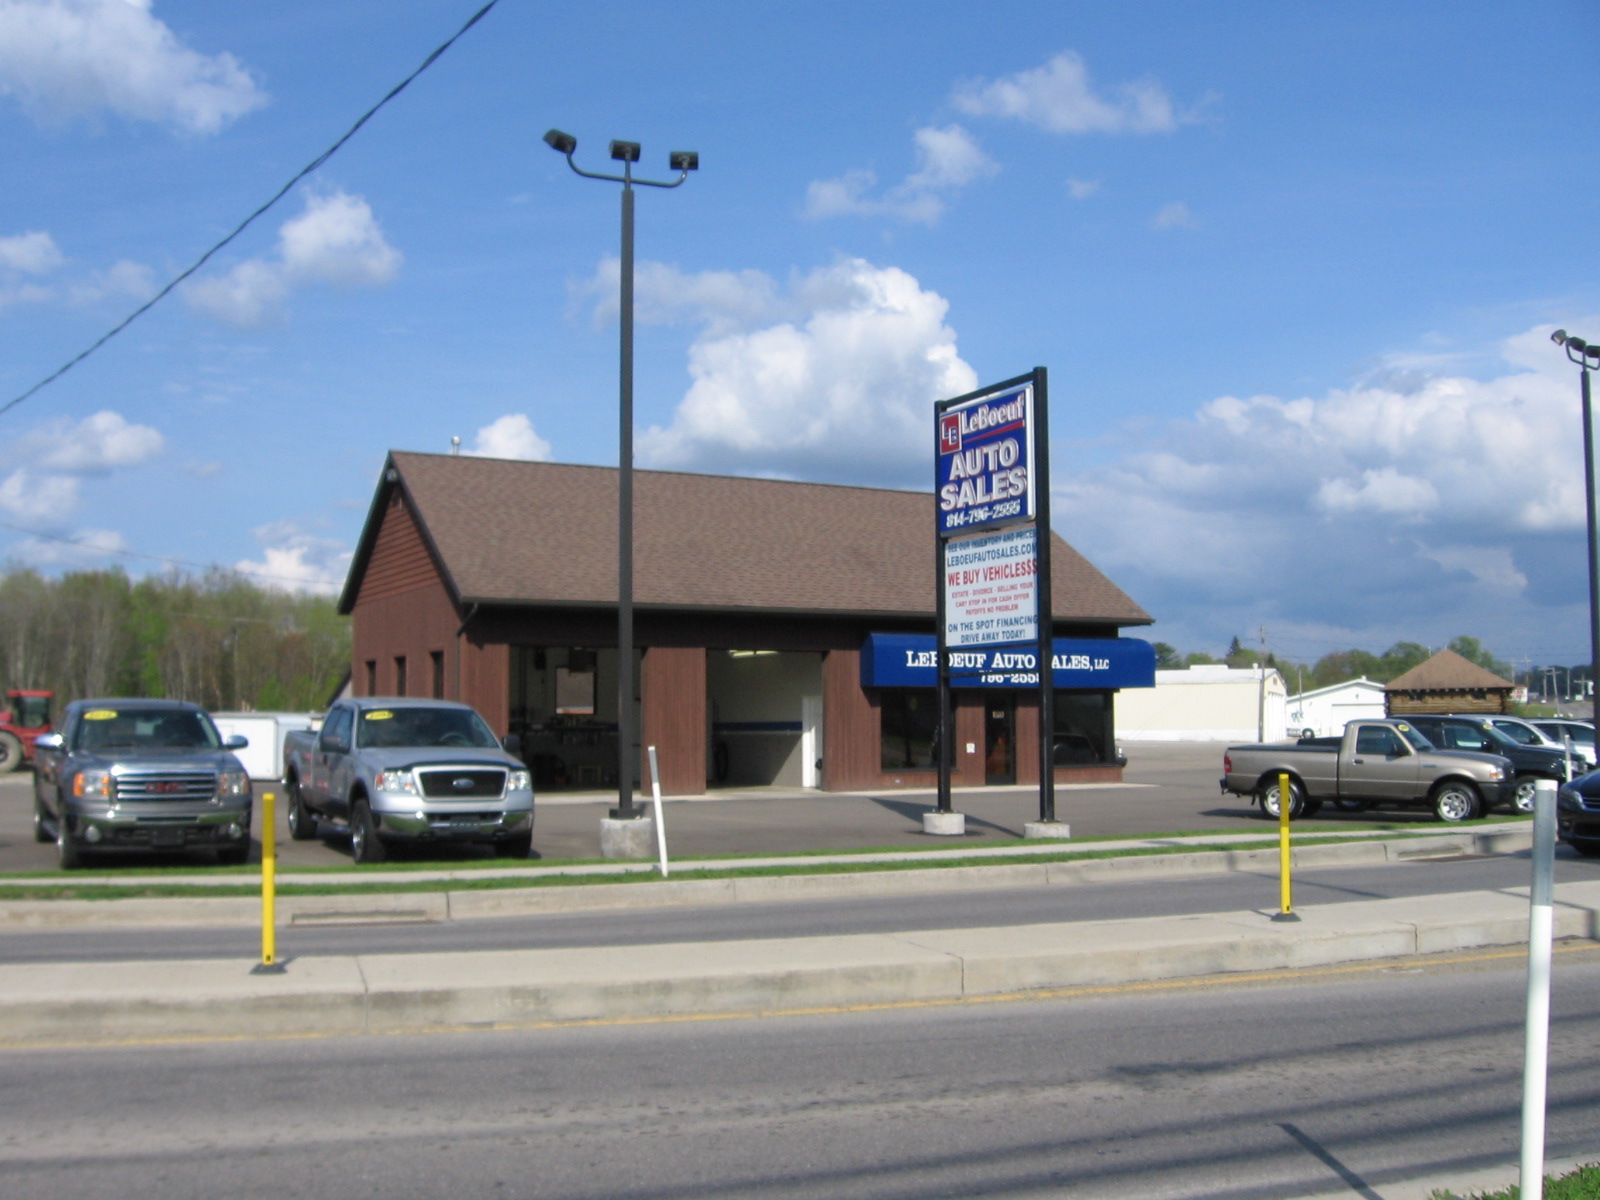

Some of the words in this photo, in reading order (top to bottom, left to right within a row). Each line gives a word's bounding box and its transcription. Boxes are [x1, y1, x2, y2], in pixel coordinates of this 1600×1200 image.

[961, 392, 1025, 435] LeBoeuf
[949, 438, 1020, 481] AUTO
[940, 466, 1027, 511] SALES
[946, 499, 1021, 528] 814-796-2555
[948, 572, 961, 587] WE
[963, 569, 980, 585] BUY
[948, 623, 958, 633] ON
[960, 621, 974, 632] THE
[976, 619, 995, 630] SPOT
[996, 614, 1039, 629] FINANCING
[960, 633, 980, 644] DRIVE
[981, 632, 1000, 642] AWAY
[991, 652, 1036, 669] AUTO
[1051, 654, 1093, 672] ALES,
[1094, 659, 1110, 670] LLC
